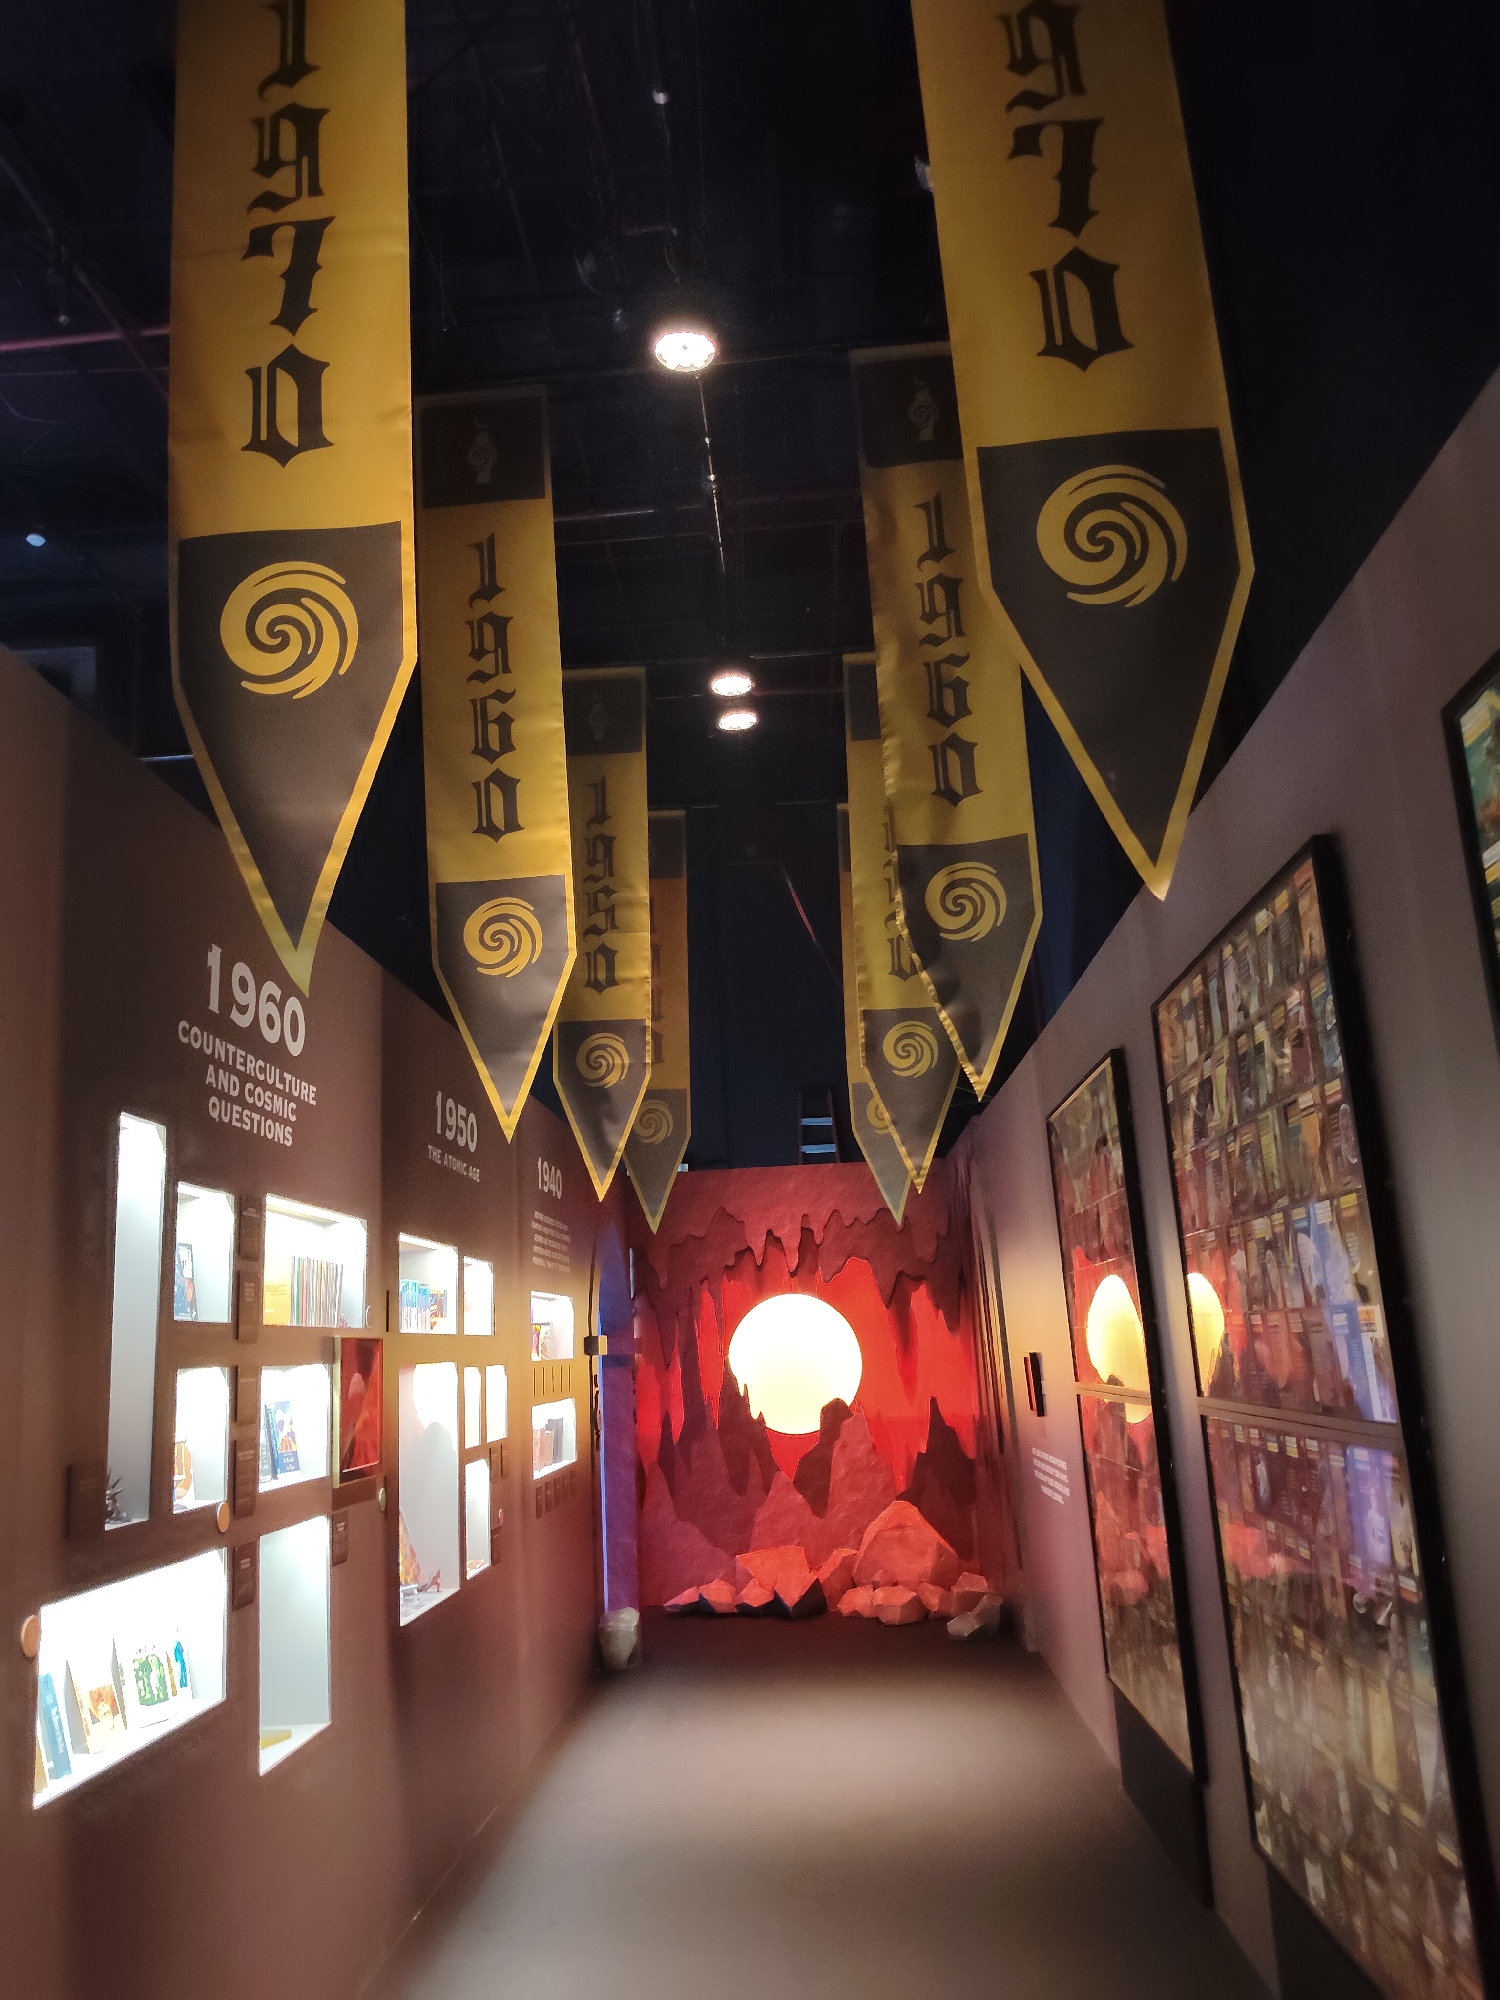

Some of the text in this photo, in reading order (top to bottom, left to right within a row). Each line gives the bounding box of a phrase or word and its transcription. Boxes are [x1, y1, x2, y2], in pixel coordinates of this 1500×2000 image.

[241, 0, 336, 468] 1970
[465, 531, 526, 843] 1960
[911, 491, 984, 808] 1960
[583, 775, 620, 995] 1950
[207, 943, 306, 1057] 1960
[178, 1020, 317, 1106] COUNTERCULTURE
[205, 1064, 297, 1122] AND COSMIC
[208, 1096, 293, 1147] QUESTIONS
[427, 1144, 480, 1183] THE ATOMIC AGE
[436, 1091, 478, 1153] 1950
[537, 1156, 563, 1200] 1940
